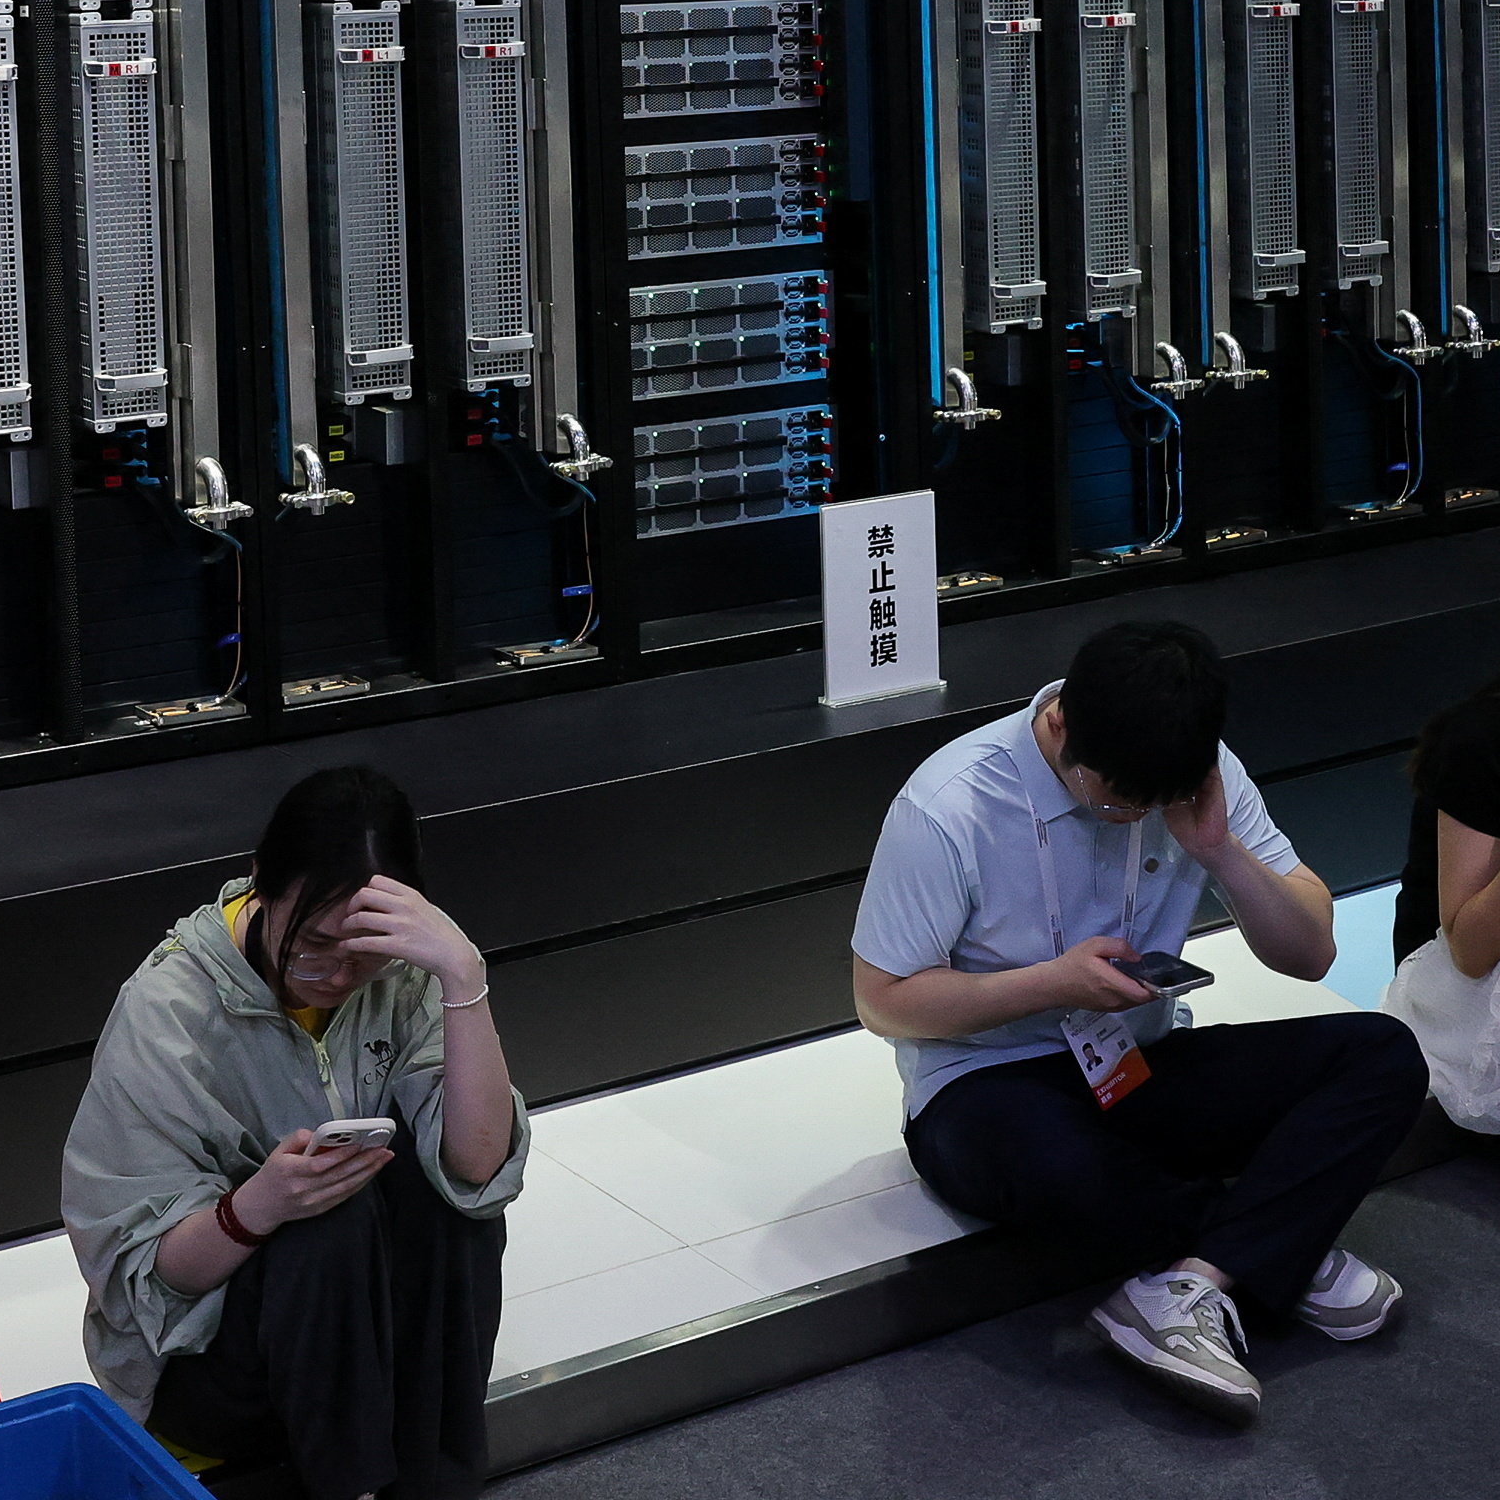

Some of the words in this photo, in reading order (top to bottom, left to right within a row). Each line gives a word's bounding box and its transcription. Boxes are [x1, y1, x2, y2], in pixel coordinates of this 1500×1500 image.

[377, 51, 389, 59] L1
[501, 47, 512, 55] R1
[126, 65, 139, 73] R1
[866, 522, 899, 670] 禁止触摸
